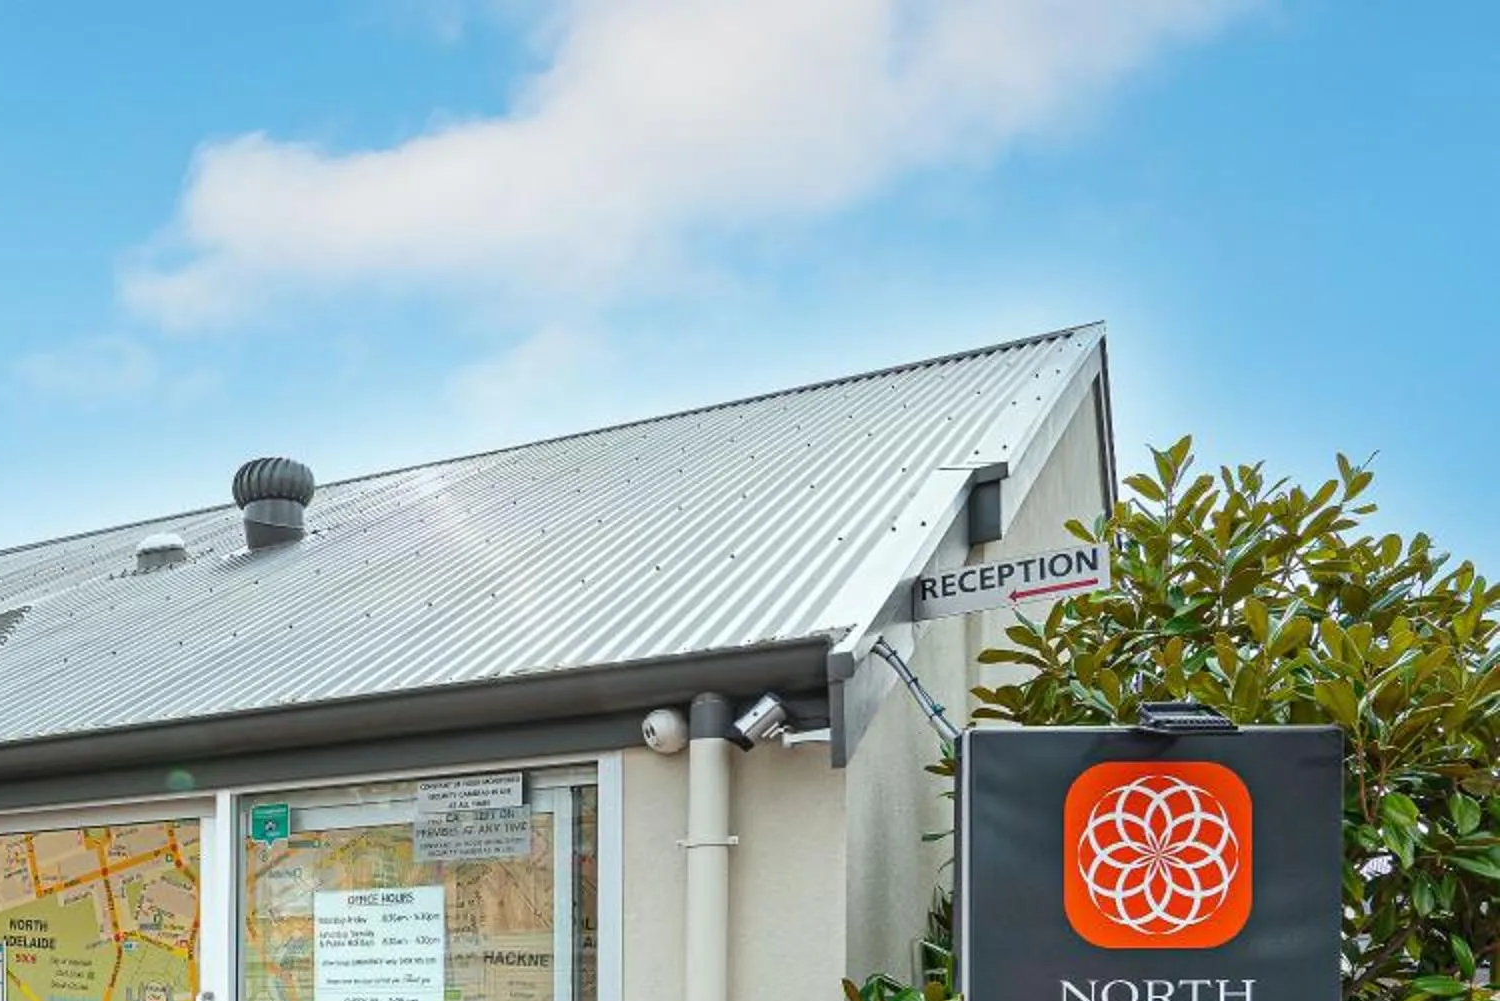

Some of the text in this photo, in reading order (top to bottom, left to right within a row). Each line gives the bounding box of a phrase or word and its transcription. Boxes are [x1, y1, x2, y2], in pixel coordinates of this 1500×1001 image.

[920, 547, 1099, 600] RECEPTION
[381, 891, 415, 904] HOURS
[9, 919, 48, 932] NORTH
[484, 951, 554, 968] HACKNE
